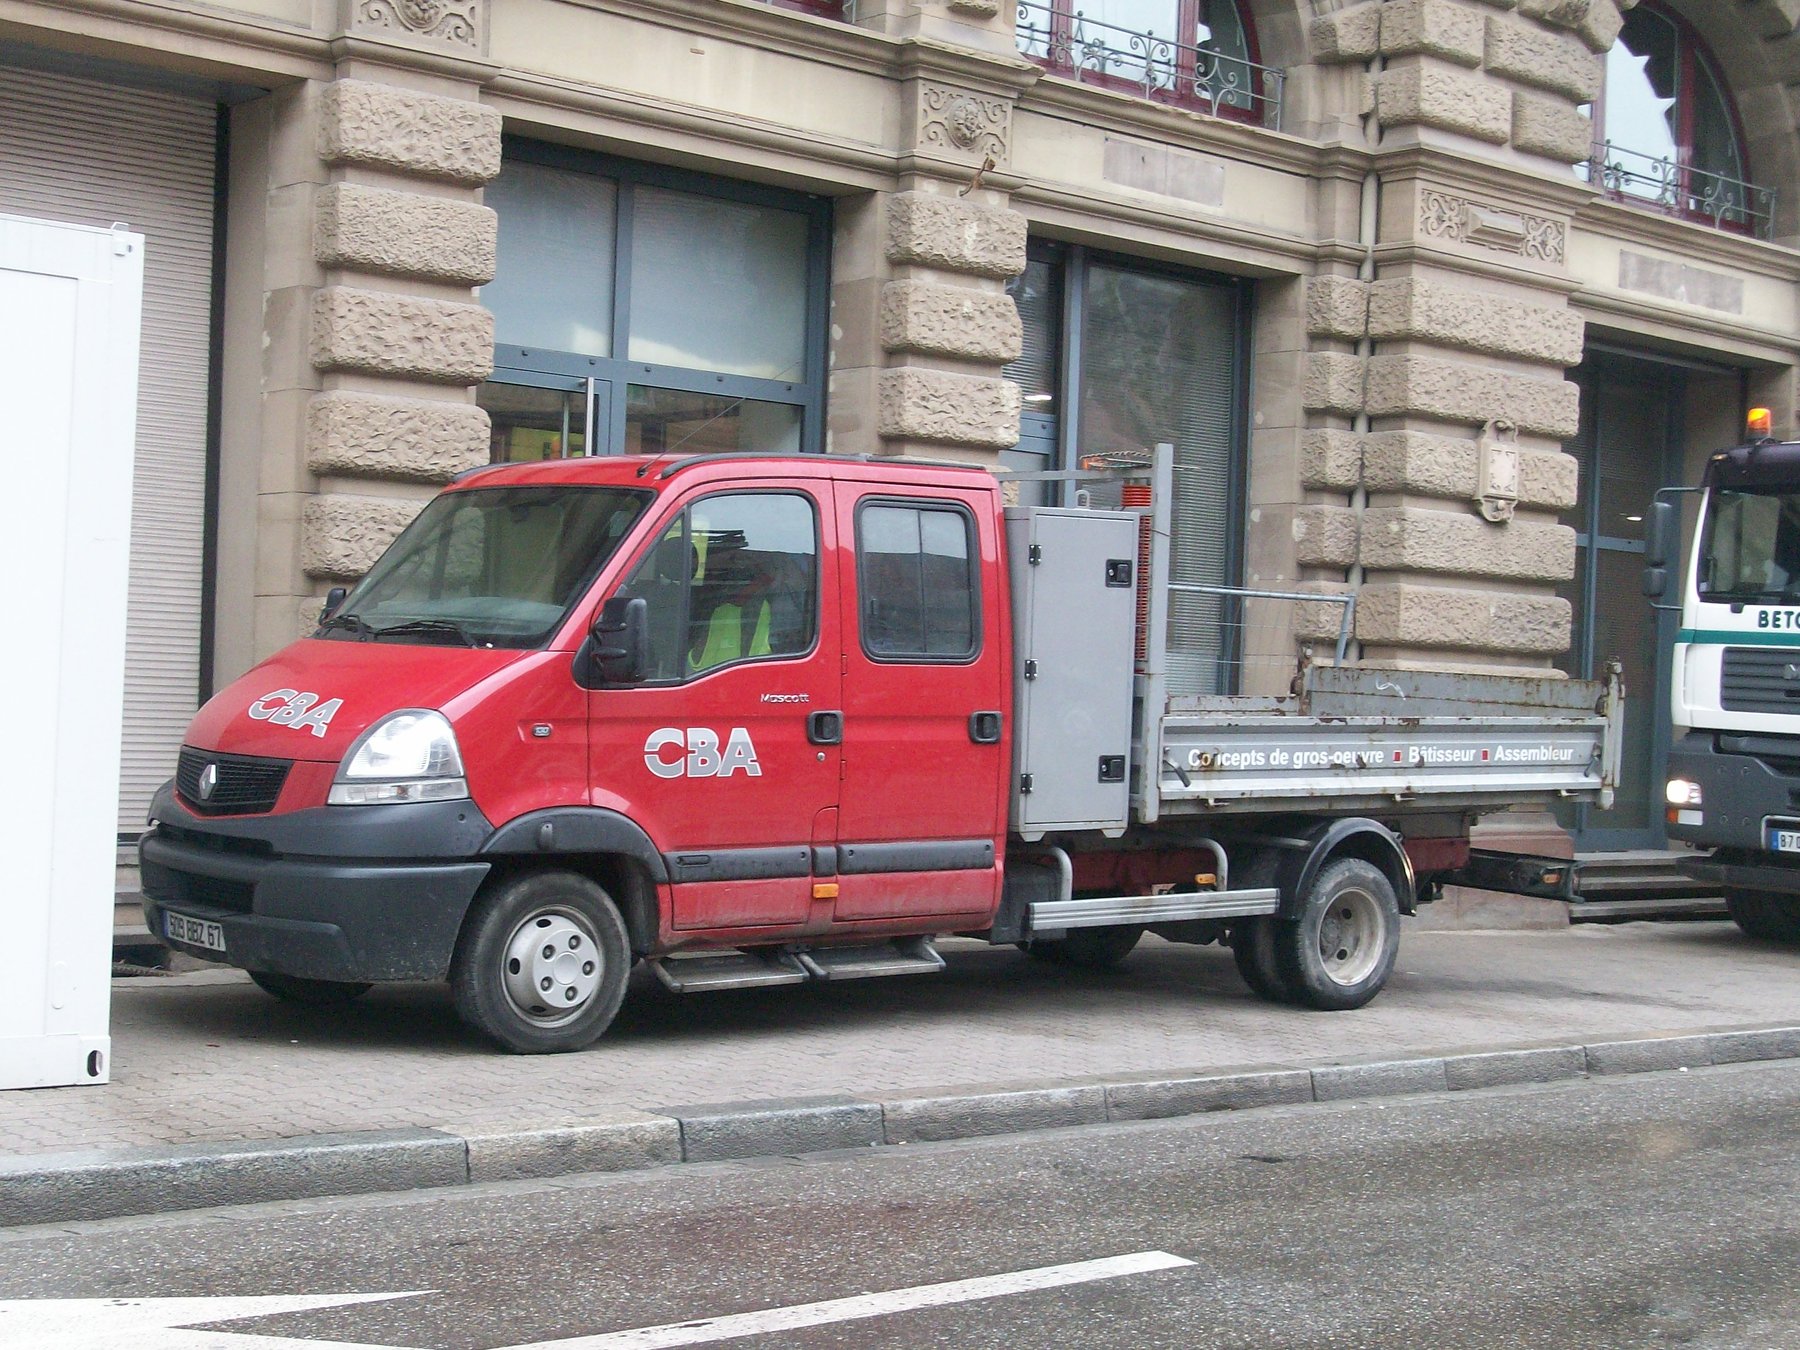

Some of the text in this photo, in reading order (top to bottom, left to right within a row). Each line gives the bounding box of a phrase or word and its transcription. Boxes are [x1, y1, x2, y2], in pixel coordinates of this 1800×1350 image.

[760, 693, 810, 703] Mascott
[248, 688, 344, 738] CBA
[644, 727, 763, 779] CBA
[1270, 748, 1289, 766] de
[1408, 745, 1477, 763] Bâtisseur
[1494, 744, 1574, 762] Assembleur
[208, 924, 221, 948] 67
